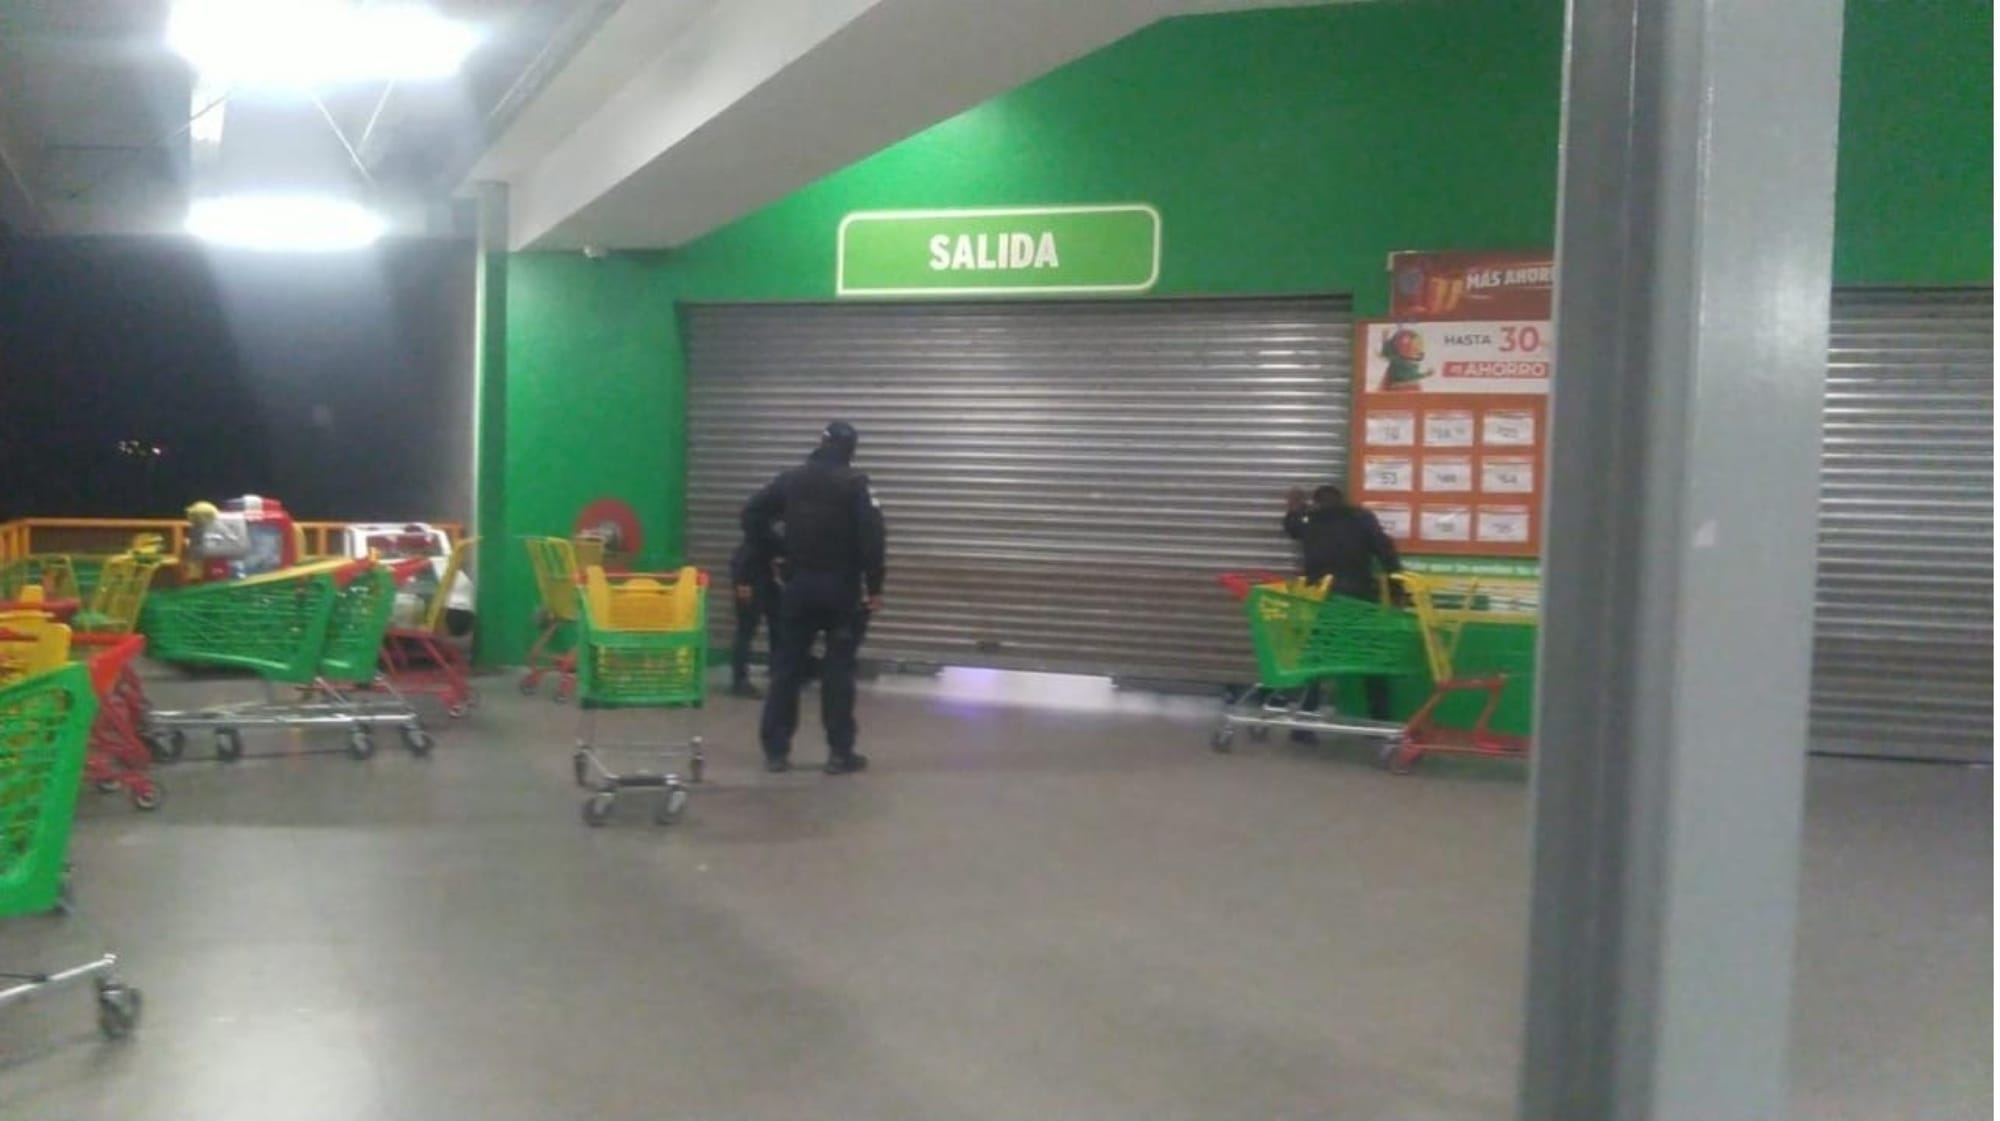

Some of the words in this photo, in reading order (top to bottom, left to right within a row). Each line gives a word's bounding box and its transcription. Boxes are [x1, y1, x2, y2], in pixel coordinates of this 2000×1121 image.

[928, 231, 1060, 271] SALIDA
[1503, 266, 1552, 286] AHOR
[1444, 334, 1492, 346] HASTA
[1463, 362, 1545, 377] AHORRO
